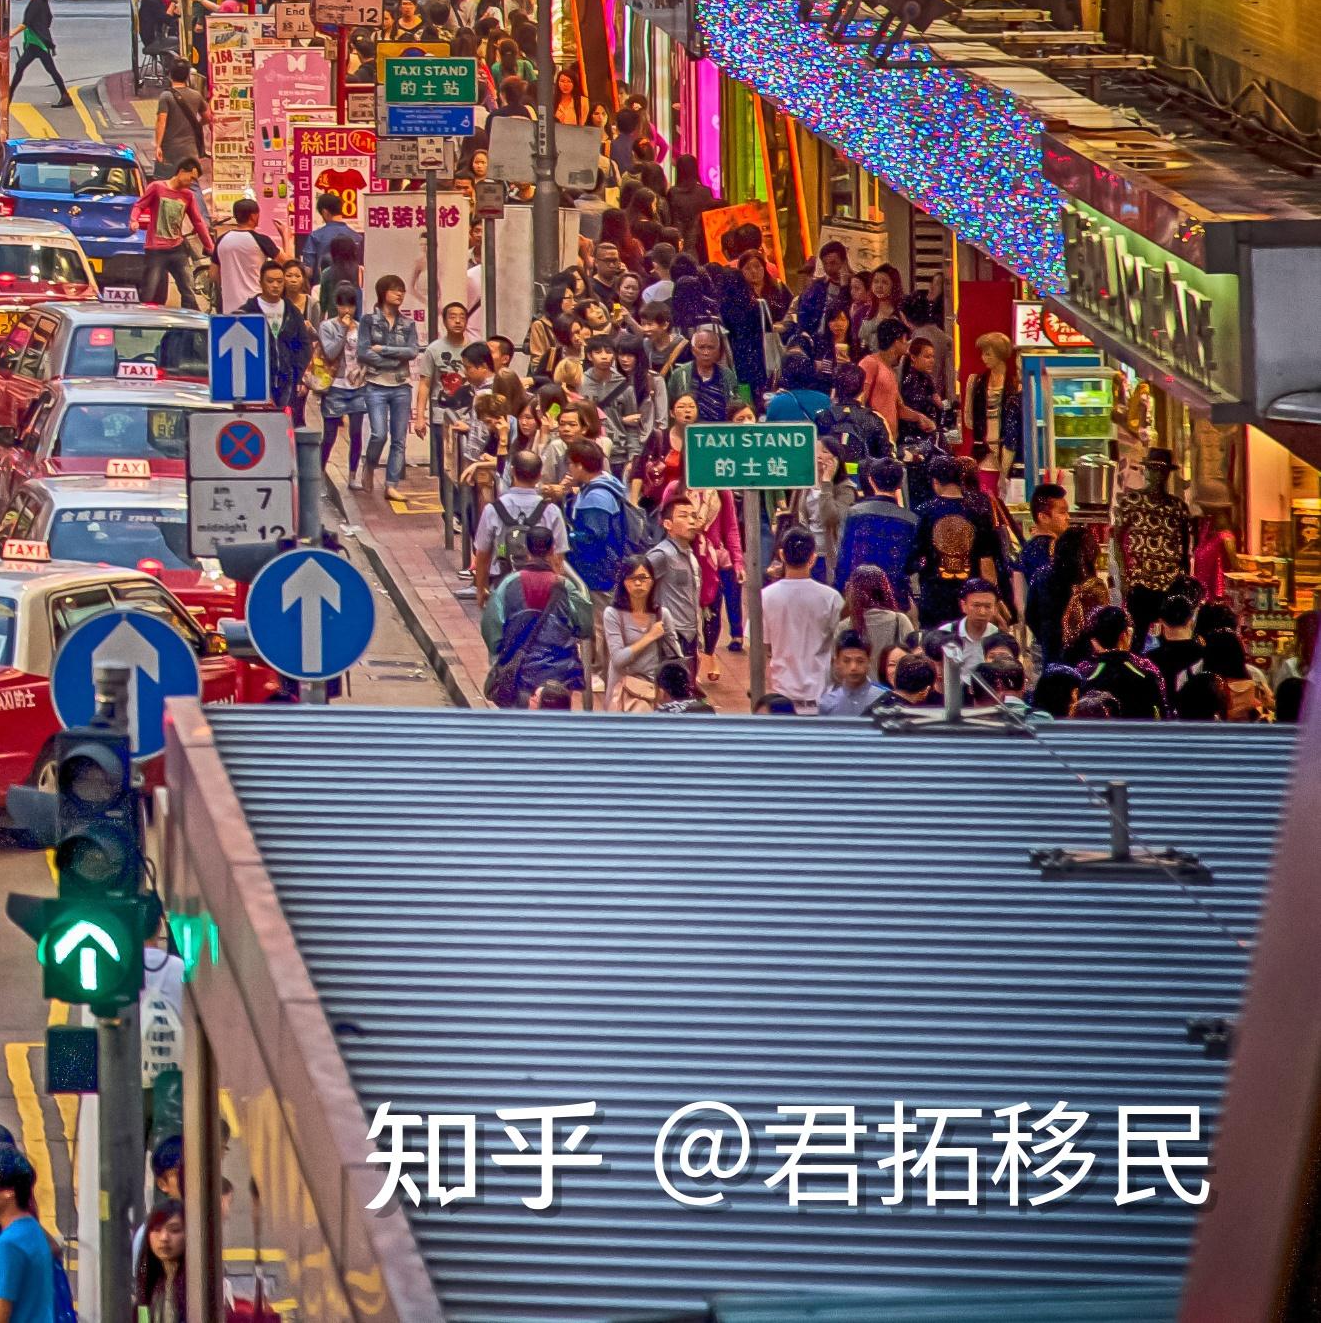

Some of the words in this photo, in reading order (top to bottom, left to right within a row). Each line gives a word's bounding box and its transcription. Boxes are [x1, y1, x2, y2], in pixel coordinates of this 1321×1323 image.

[286, 7, 305, 16] End
[358, 8, 378, 23] 12
[393, 66, 420, 76] TAXI
[424, 66, 468, 76] STAND
[400, 80, 459, 96] 的士站
[301, 131, 347, 155] 絲印
[106, 289, 136, 300] TAXI
[122, 366, 153, 376] TAXI
[693, 432, 737, 447] TAXI
[742, 431, 807, 447] STAND
[112, 462, 150, 475] TAXI
[715, 457, 788, 479] 的士站
[256, 487, 272, 509] 7
[7, 542, 48, 559] TAXI
